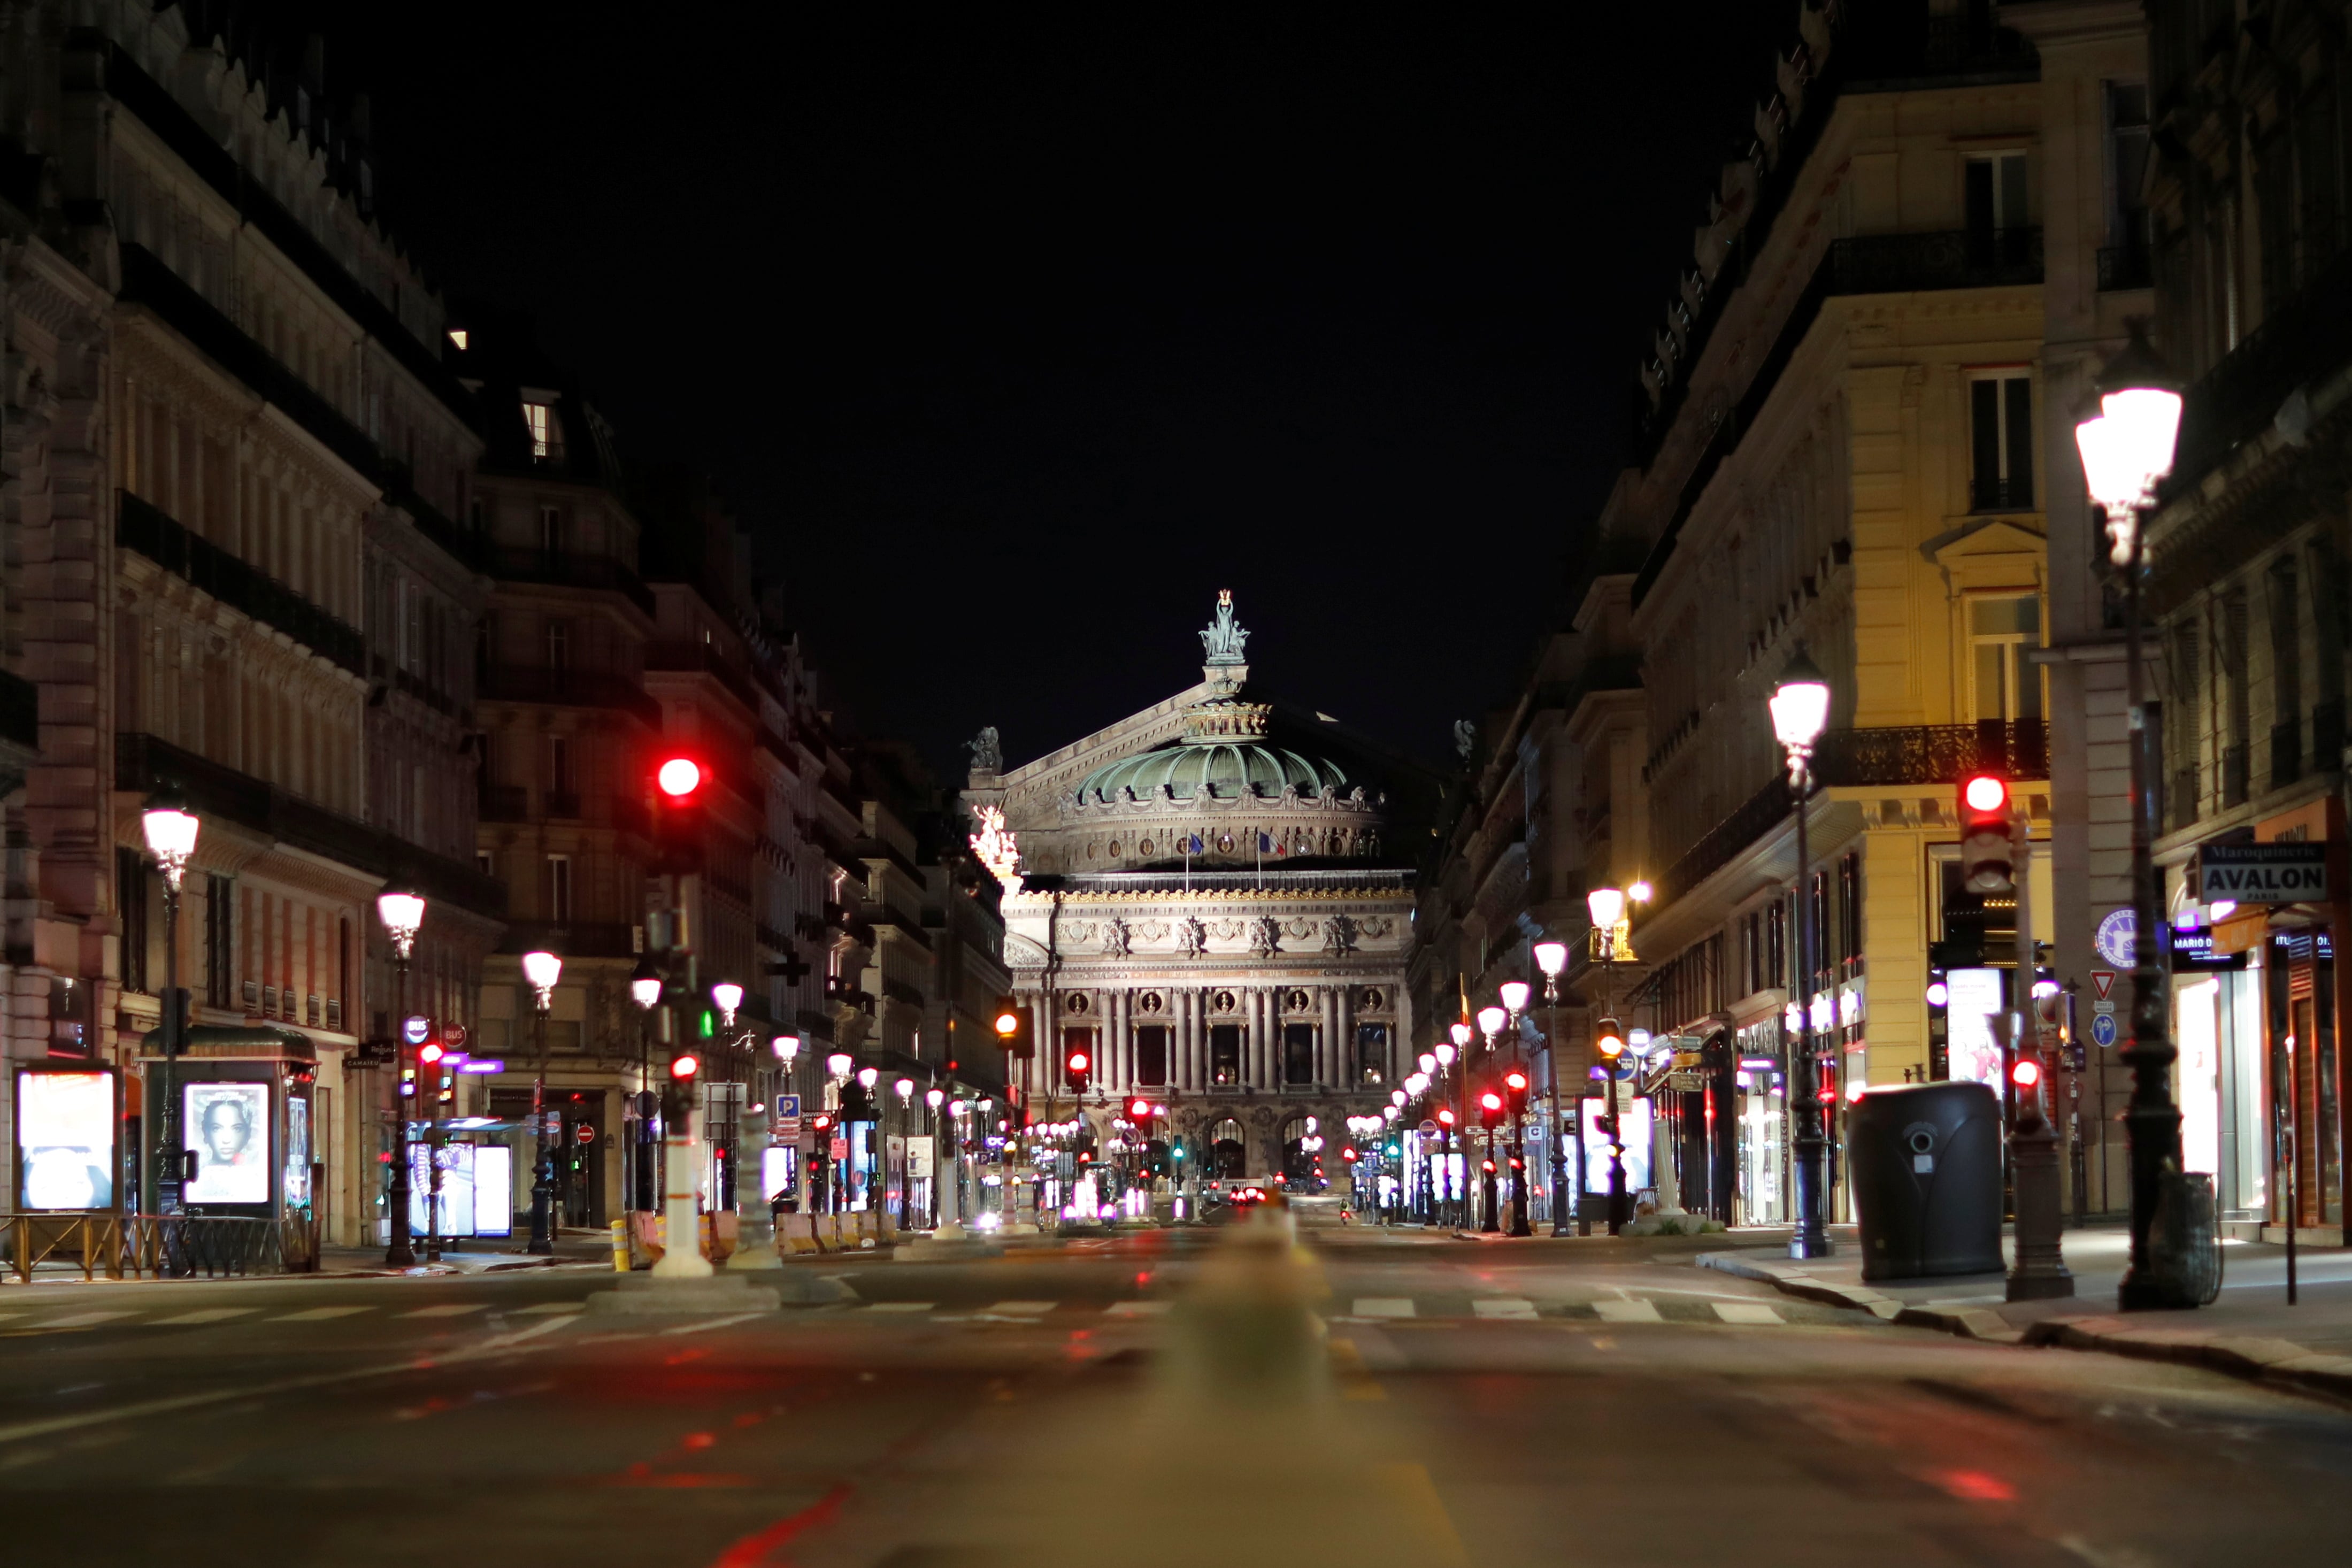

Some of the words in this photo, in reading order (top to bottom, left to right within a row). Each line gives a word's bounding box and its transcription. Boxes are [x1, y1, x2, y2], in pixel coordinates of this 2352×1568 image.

[2211, 844, 2317, 860] Maroquinerie
[2207, 868, 2322, 890] AVALON
[2174, 938, 2204, 948] MARIO
[408, 1020, 426, 1031] BUS
[445, 1030, 462, 1039] BUS
[371, 1046, 391, 1055] Regus
